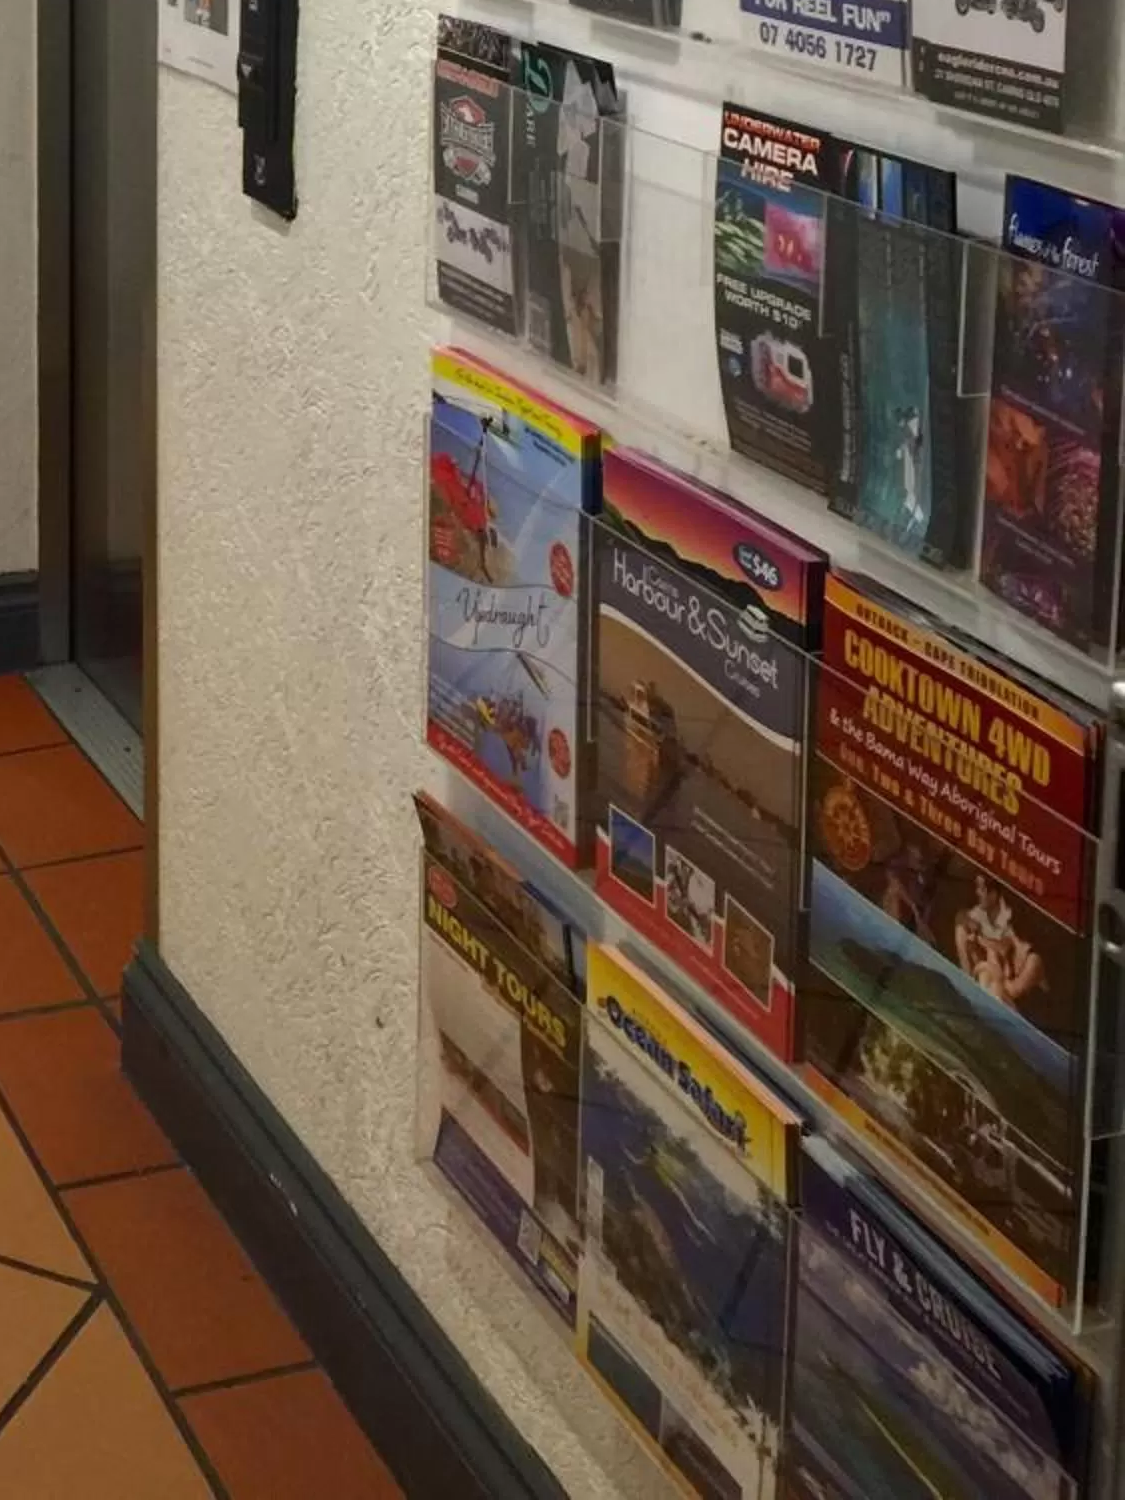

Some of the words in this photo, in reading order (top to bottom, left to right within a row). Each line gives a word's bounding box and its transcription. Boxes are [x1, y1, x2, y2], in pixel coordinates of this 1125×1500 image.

[760, 21, 779, 47] 07
[784, 27, 827, 60] 4056
[835, 40, 876, 71] 1727
[723, 127, 818, 176] CAMERA
[725, 111, 820, 153] UNDERWATER
[741, 158, 794, 193] HIRE
[717, 272, 747, 295] FREE
[750, 287, 811, 321] UPGRADE
[725, 289, 770, 317] WORTH
[752, 553, 779, 587] $46
[613, 548, 685, 624] Harbour
[688, 595, 707, 641] &
[706, 607, 779, 690] Sunset
[856, 603, 909, 642] OUTBACK
[925, 641, 956, 669] CAPE
[960, 660, 1042, 721] TRIBULATION
[844, 628, 981, 743] COOKTOWN
[988, 716, 1051, 788] 4WD
[863, 685, 1023, 816] ADVENTURES
[829, 707, 840, 727] &
[842, 714, 863, 742] the
[865, 731, 904, 771] Bama
[907, 759, 939, 798] Way
[940, 781, 1017, 844] Aboriginal
[1018, 831, 1063, 877] Tours
[919, 795, 962, 839] Three
[967, 825, 995, 865] Day
[999, 850, 1045, 898] Tours
[428, 895, 490, 971] NIGHT
[492, 956, 568, 1049] TOURS
[606, 995, 675, 1080] Ocean
[850, 1208, 887, 1269] FLY
[893, 1251, 913, 1294] &
